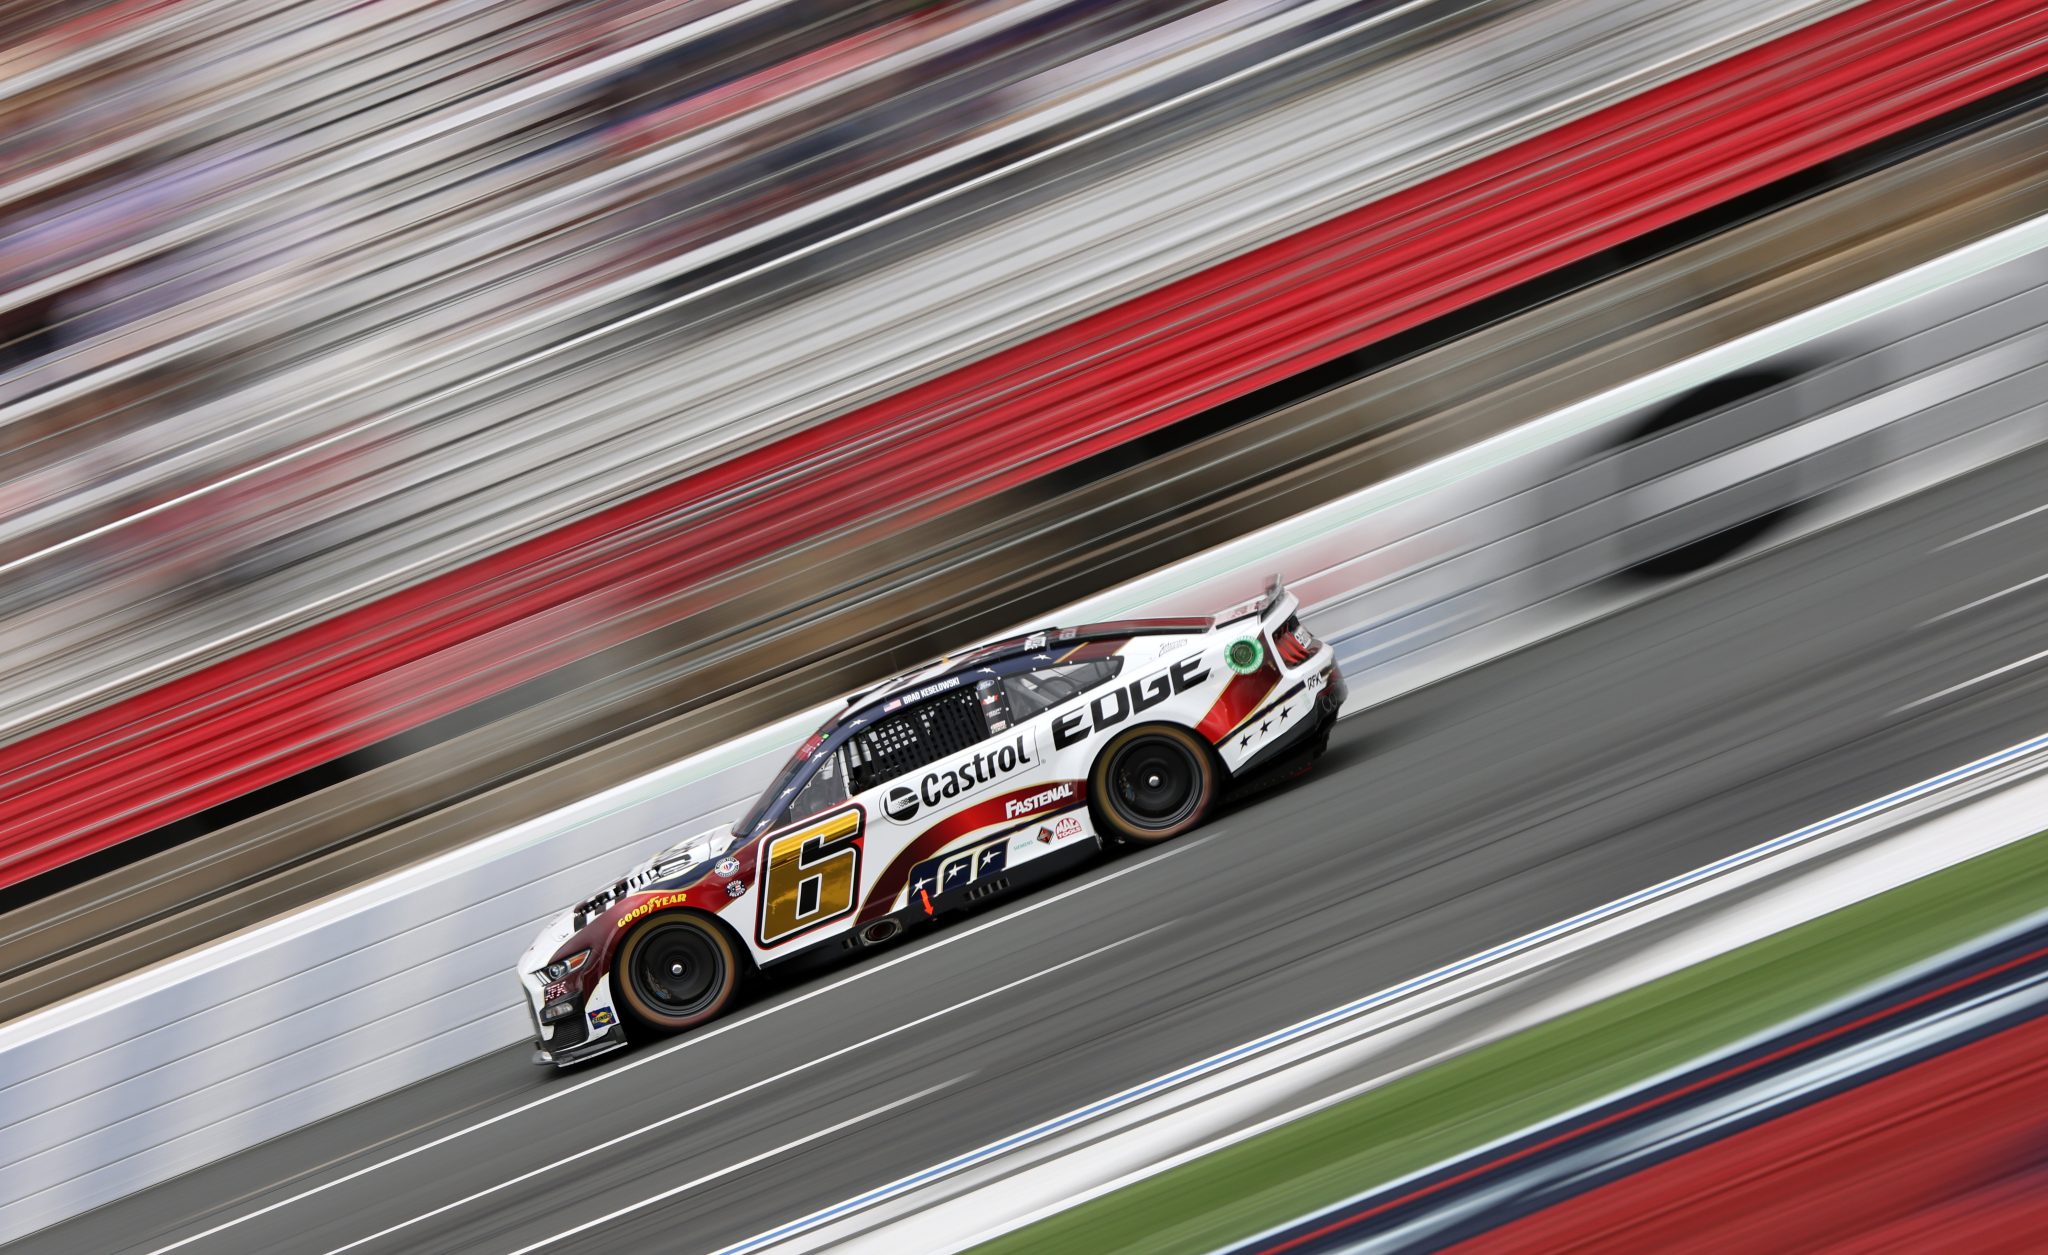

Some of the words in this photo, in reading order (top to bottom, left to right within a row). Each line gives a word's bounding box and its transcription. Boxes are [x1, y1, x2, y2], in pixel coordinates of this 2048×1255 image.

[902, 692, 921, 705] BRAD
[920, 676, 960, 698] KESELOWSKI
[1051, 649, 1211, 752] EDGE
[920, 735, 1031, 807] Castrol
[1005, 783, 1073, 820] FASTENAL
[1056, 817, 1080, 834] MAC
[1057, 826, 1082, 839] TOOLS
[758, 806, 864, 946] 6
[617, 893, 687, 927] GOODYEAR
